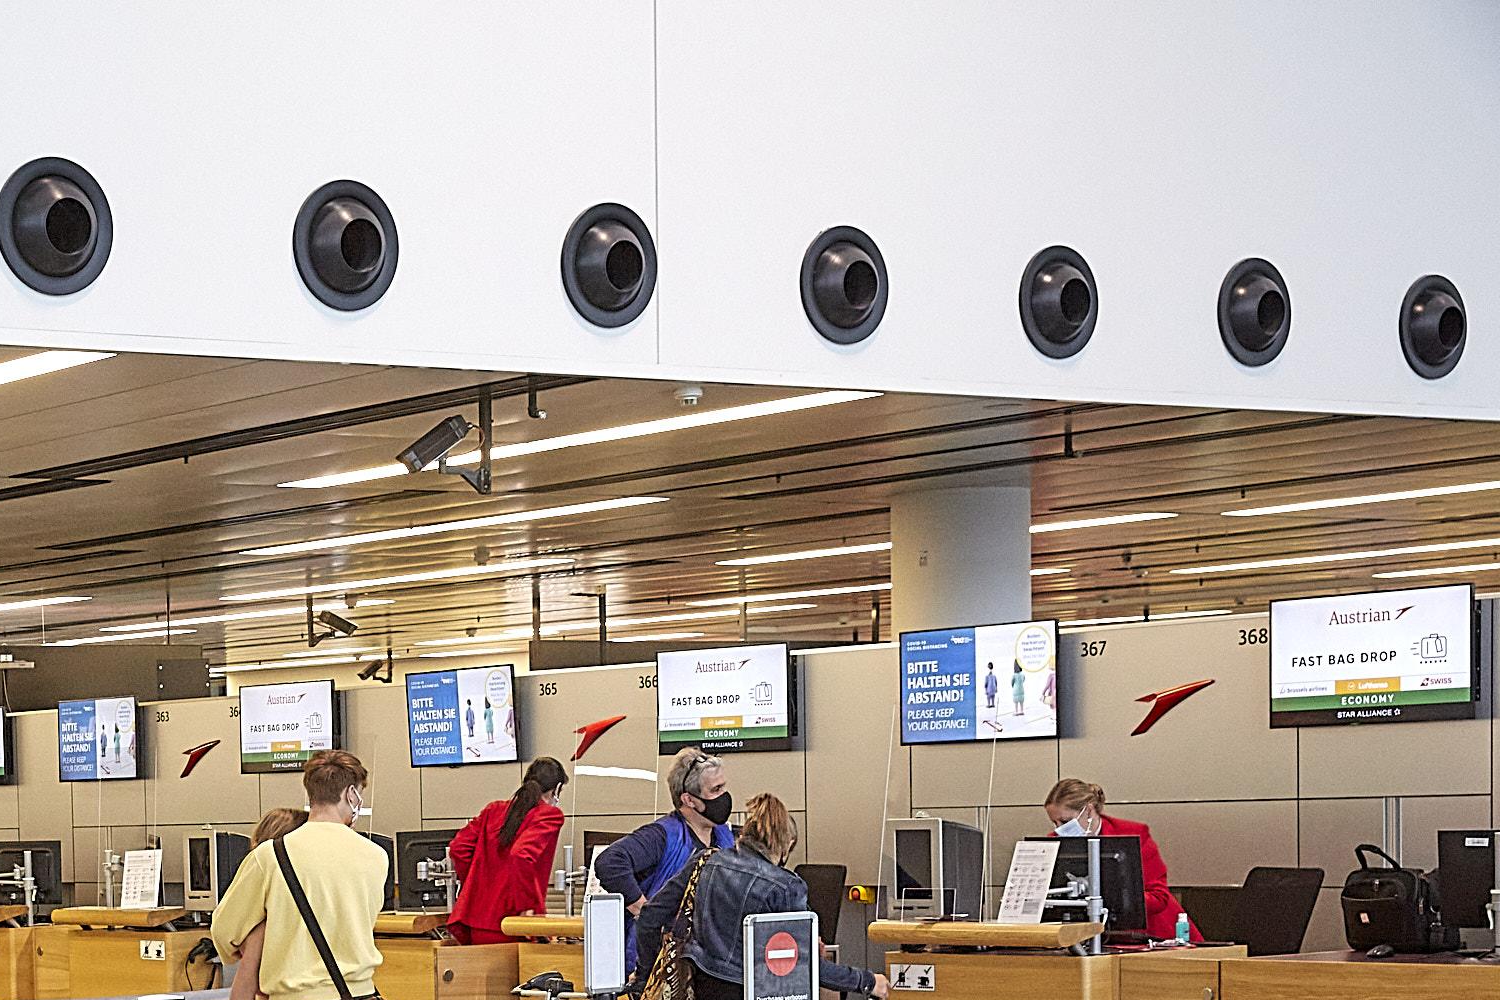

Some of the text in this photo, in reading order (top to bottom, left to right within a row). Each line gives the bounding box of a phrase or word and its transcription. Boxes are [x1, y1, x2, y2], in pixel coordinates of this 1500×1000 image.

[1329, 608, 1391, 625] Austrian
[1238, 628, 1268, 646] 368
[1080, 641, 1106, 656] 367
[1291, 650, 1397, 668] FAST BAG DROP
[695, 661, 736, 673] Austrian
[907, 660, 938, 674] BITTE
[907, 673, 970, 689] HALTEN SIE
[1430, 677, 1452, 685] SWISS
[539, 683, 558, 696] 365
[267, 694, 296, 705] Austrian
[412, 697, 434, 708] BITTE
[671, 694, 740, 706] FAST BAG DROP
[907, 689, 964, 704] ABSTAND!
[1341, 694, 1395, 706] ECONOMY
[156, 711, 170, 722] 363
[229, 706, 240, 718] 36
[413, 708, 456, 721] HALTEN SIE
[908, 708, 954, 720] PLEASE KEEP
[1356, 709, 1392, 717] ALLIANCE
[62, 722, 78, 732] BITTE
[250, 723, 299, 733] FAST BAG DROP
[414, 721, 453, 734] ABSTAND!
[908, 718, 969, 731] YOUR DISTANCE!
[62, 732, 94, 742] HALTEN SIE
[704, 729, 739, 738] ECONOMY
[415, 736, 447, 746] PLEASE KEEP
[62, 743, 91, 753] ABSTAND!
[415, 747, 430, 756] YOUR
[273, 752, 299, 760] ECONOMY
